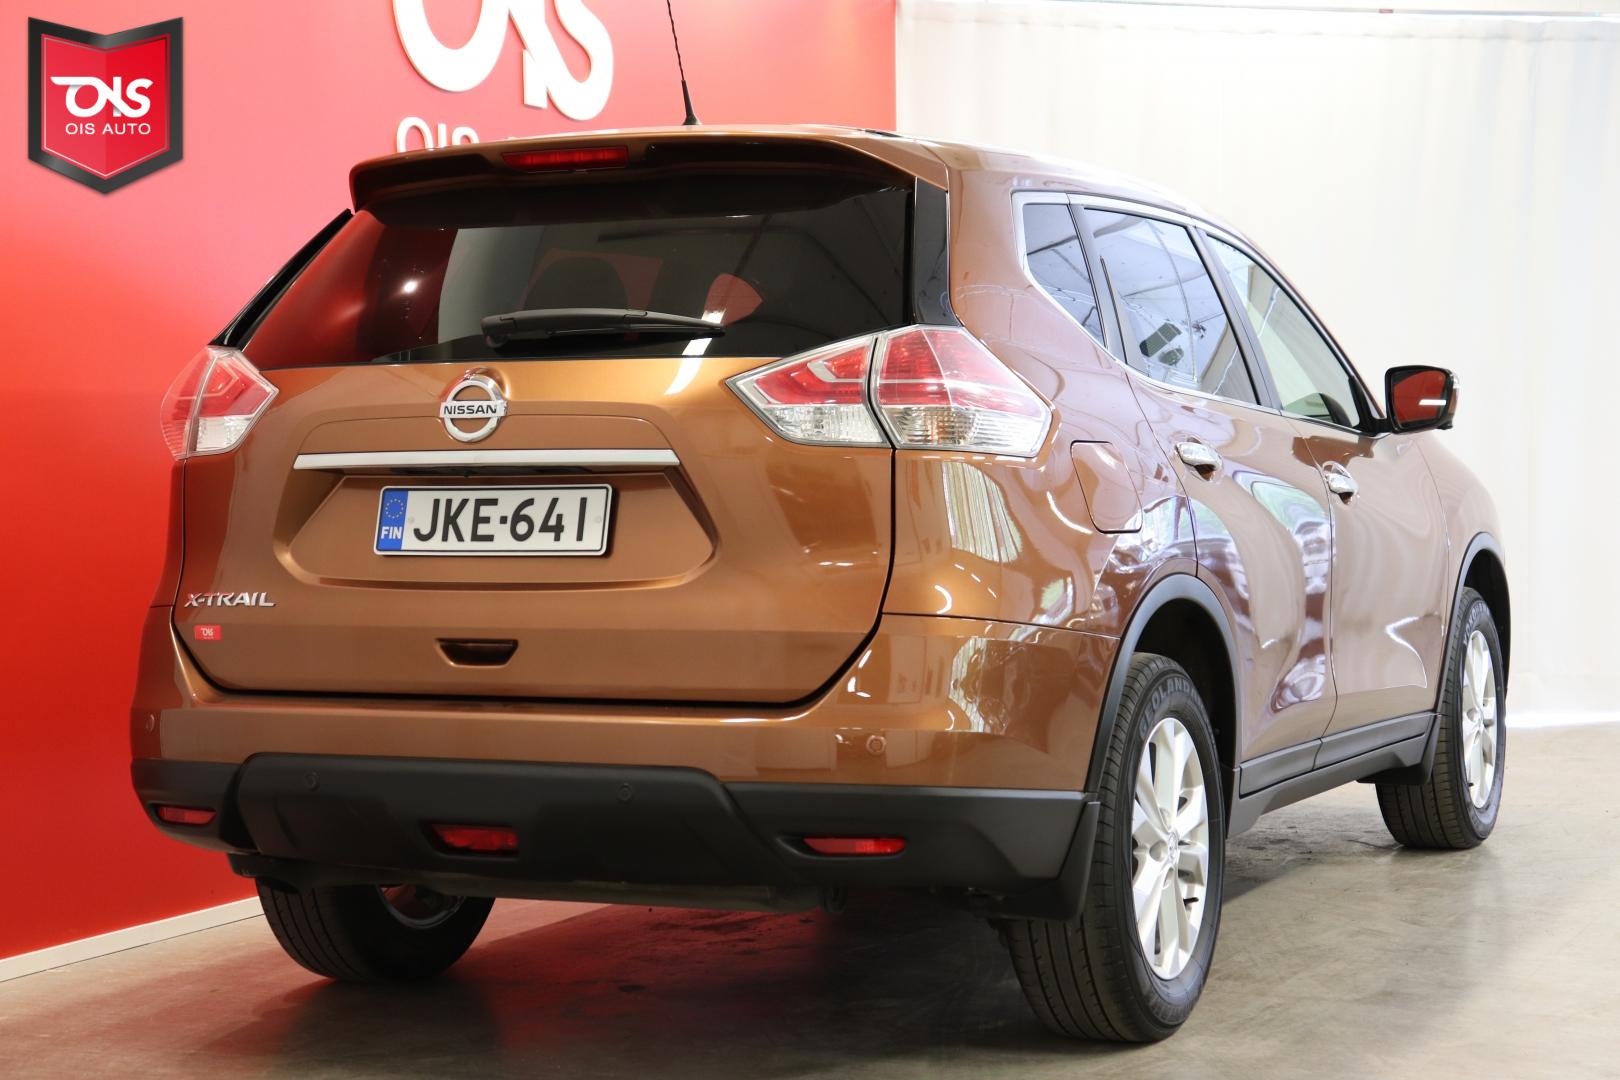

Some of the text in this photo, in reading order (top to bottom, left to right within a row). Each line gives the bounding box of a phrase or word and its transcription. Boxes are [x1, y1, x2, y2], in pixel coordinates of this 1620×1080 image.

[444, 405, 497, 415] NISSAN
[413, 497, 588, 542] JKE-641
[381, 526, 402, 540] FIN
[184, 592, 275, 607] X-TRAIL
